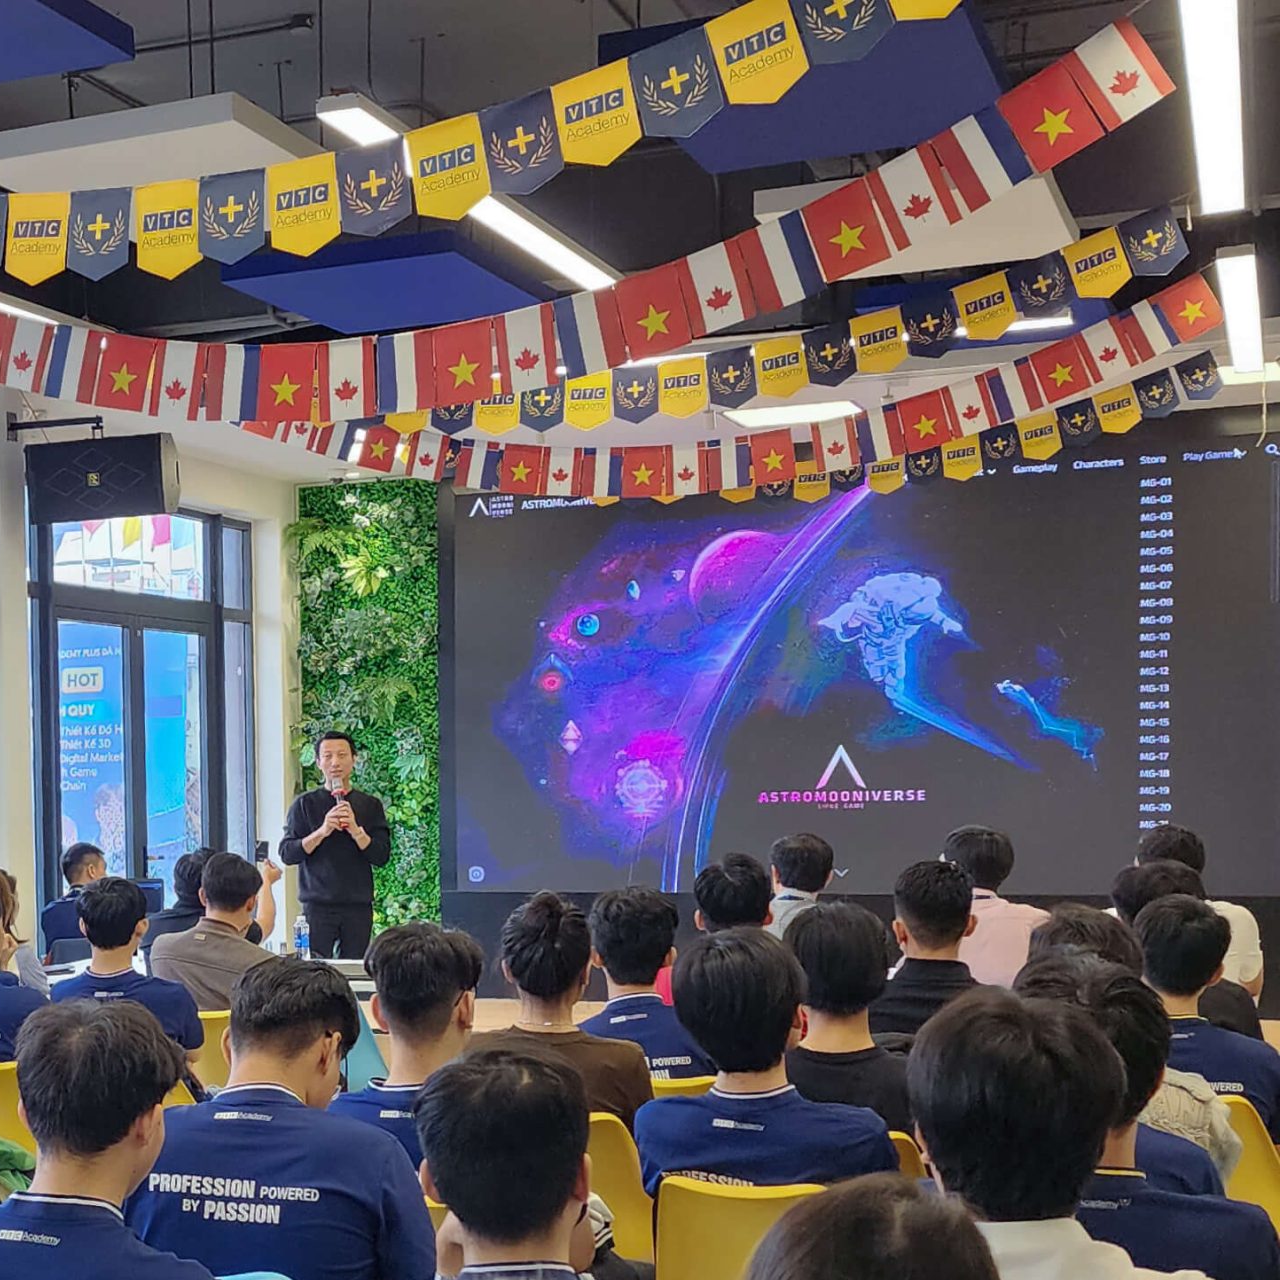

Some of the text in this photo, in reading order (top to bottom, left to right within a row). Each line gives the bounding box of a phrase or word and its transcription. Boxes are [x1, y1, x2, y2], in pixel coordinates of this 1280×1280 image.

[723, 21, 787, 65] VTC
[729, 45, 794, 82] Academy
[564, 89, 623, 124] VTC
[566, 112, 630, 142] Academy
[420, 145, 475, 176] VTC
[420, 168, 481, 193] Academy
[276, 184, 328, 210] VTC
[144, 209, 192, 230] VTC
[275, 206, 333, 227] Academy
[14, 220, 61, 237] VTC
[142, 233, 196, 249] Academy
[11, 241, 61, 256] Academy
[1075, 248, 1117, 272] VTC
[965, 292, 1005, 314] VTC
[859, 326, 897, 345] VTC
[762, 352, 799, 370] VTC
[663, 374, 701, 388] VTC
[570, 388, 605, 400] VTC
[1100, 398, 1131, 413] VTC
[1024, 425, 1054, 440] VTC
[1139, 455, 1167, 464] Store
[1183, 452, 1204, 462] Play
[1013, 463, 1058, 475] Gameplay
[1073, 458, 1124, 470] Characters
[1139, 477, 1171, 487] MG-01
[1139, 494, 1172, 504] MG-02
[1139, 512, 1172, 522] MG-03
[1139, 529, 1173, 538] MG-04
[1139, 546, 1173, 556] MG-05
[1139, 580, 1172, 590] MG-07
[1139, 632, 1170, 642] MG-10
[1139, 650, 1168, 659] MG-11
[1139, 666, 1169, 676] MG-12
[67, 673, 99, 687] HOT
[1139, 684, 1169, 692] MG-13
[1139, 701, 1169, 710] MG-14
[1139, 718, 1169, 727] MG-15
[1139, 735, 1169, 744] MG-16
[1139, 752, 1169, 761] MG-17
[1139, 769, 1169, 778] MG-18
[758, 789, 926, 804] ASTROMOONIVERSE
[1139, 786, 1169, 795] MG-19
[1139, 803, 1171, 812] MG-20
[652, 1055, 692, 1068] POWERED
[1208, 1081, 1244, 1092] WERED
[148, 1173, 320, 1202] PROFESSION POWERED
[182, 1198, 280, 1224] BY PASSION
[22, 1231, 61, 1246] Academy
